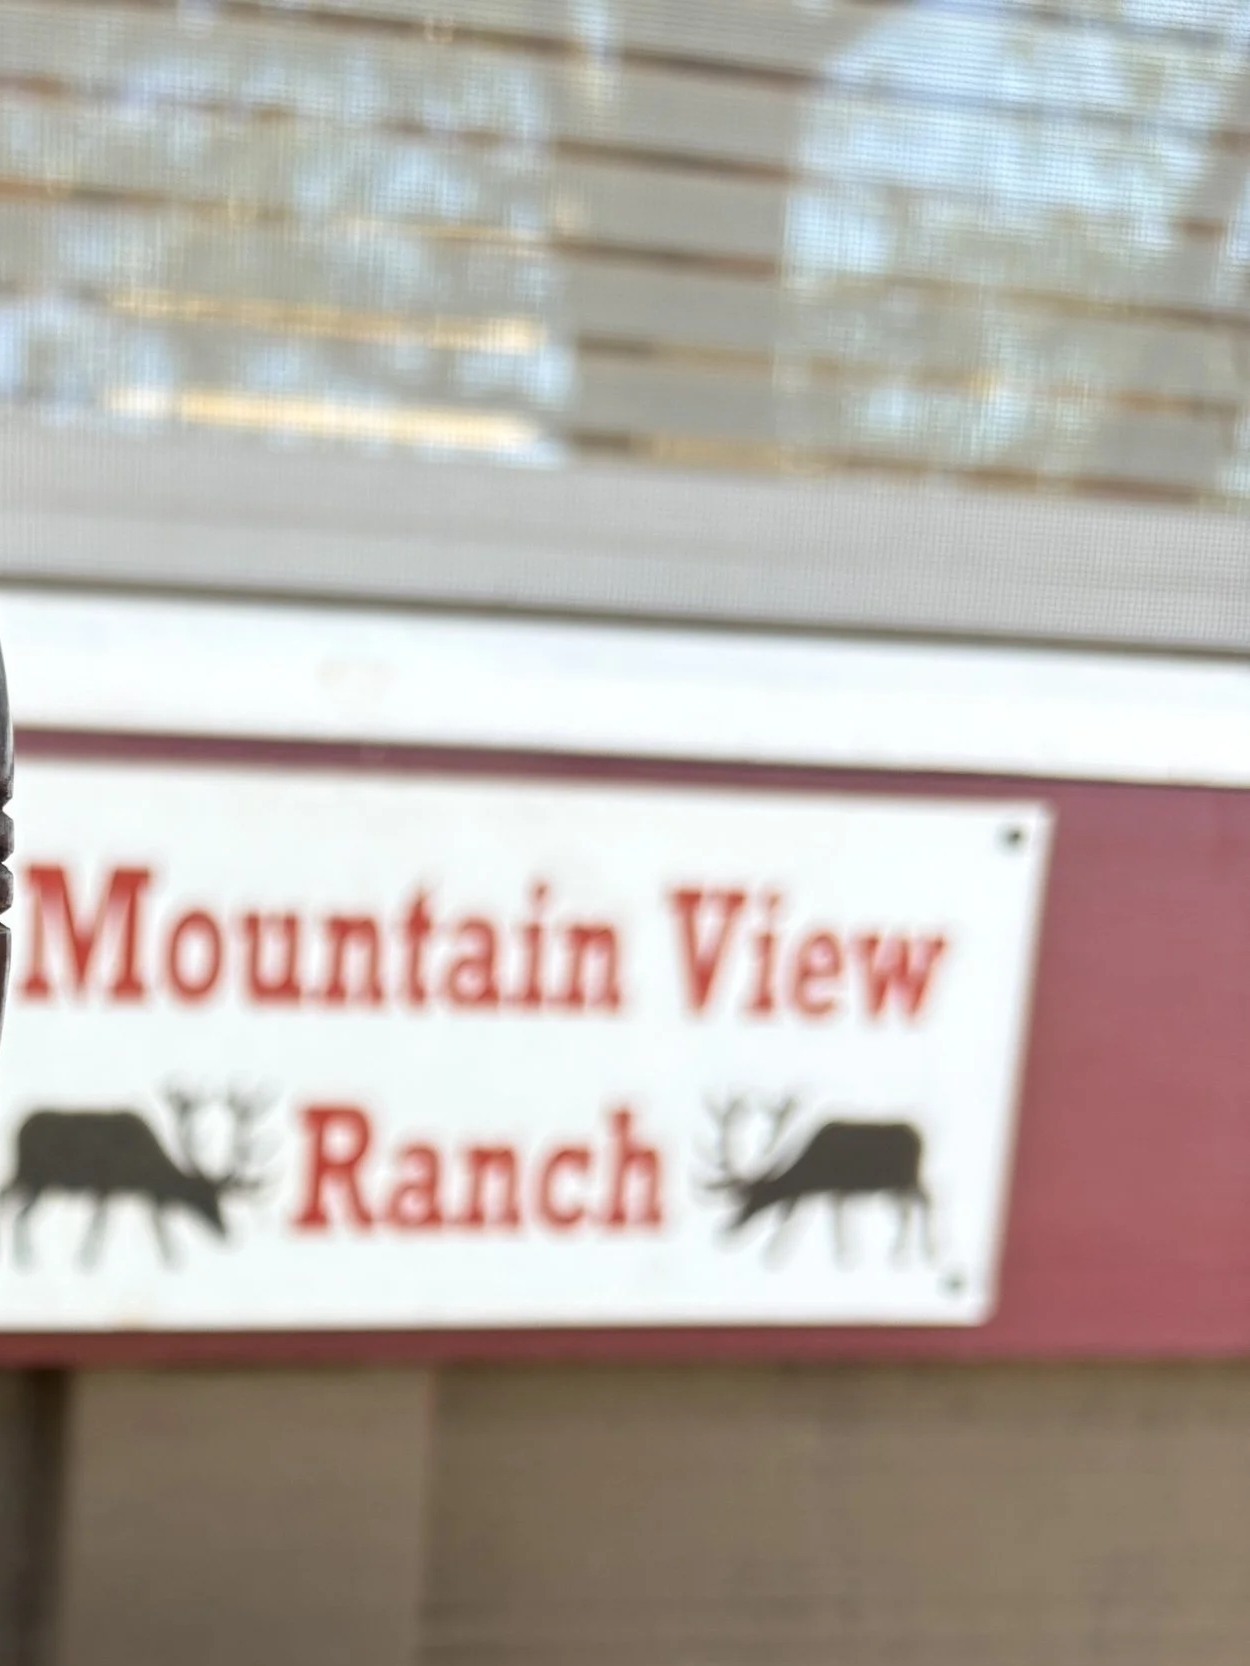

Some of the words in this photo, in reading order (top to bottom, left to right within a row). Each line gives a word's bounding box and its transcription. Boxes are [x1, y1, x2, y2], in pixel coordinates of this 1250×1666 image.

[16, 862, 622, 1010] Mountain
[668, 886, 947, 1018] View
[293, 1102, 665, 1232] Ranch
